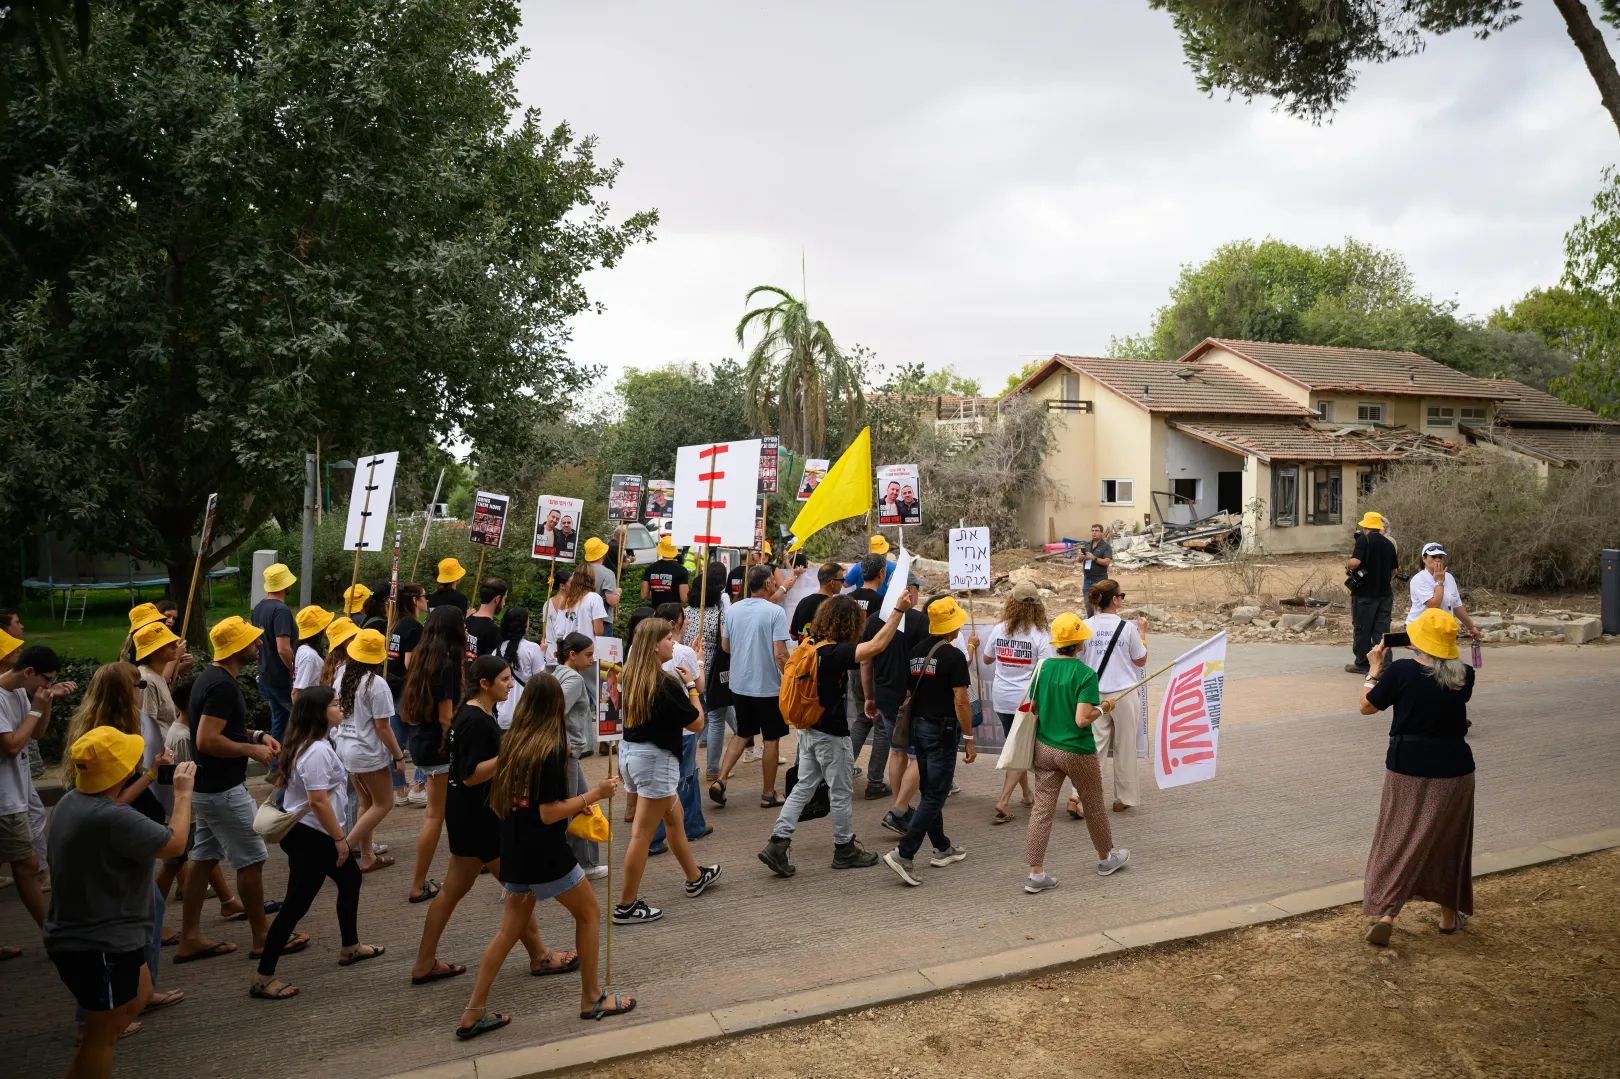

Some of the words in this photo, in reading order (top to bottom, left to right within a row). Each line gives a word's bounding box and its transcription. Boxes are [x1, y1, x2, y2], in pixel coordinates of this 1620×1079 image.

[956, 530, 978, 541] את
[957, 546, 987, 560] אחיי
[965, 564, 981, 573] אני
[951, 576, 988, 587] מבקשת
[997, 638, 1010, 647] אותם
[1011, 640, 1031, 650] מחזירים
[1014, 649, 1032, 658] הביתה
[1204, 677, 1220, 703] THEM
[1170, 662, 1214, 767] NOW!
